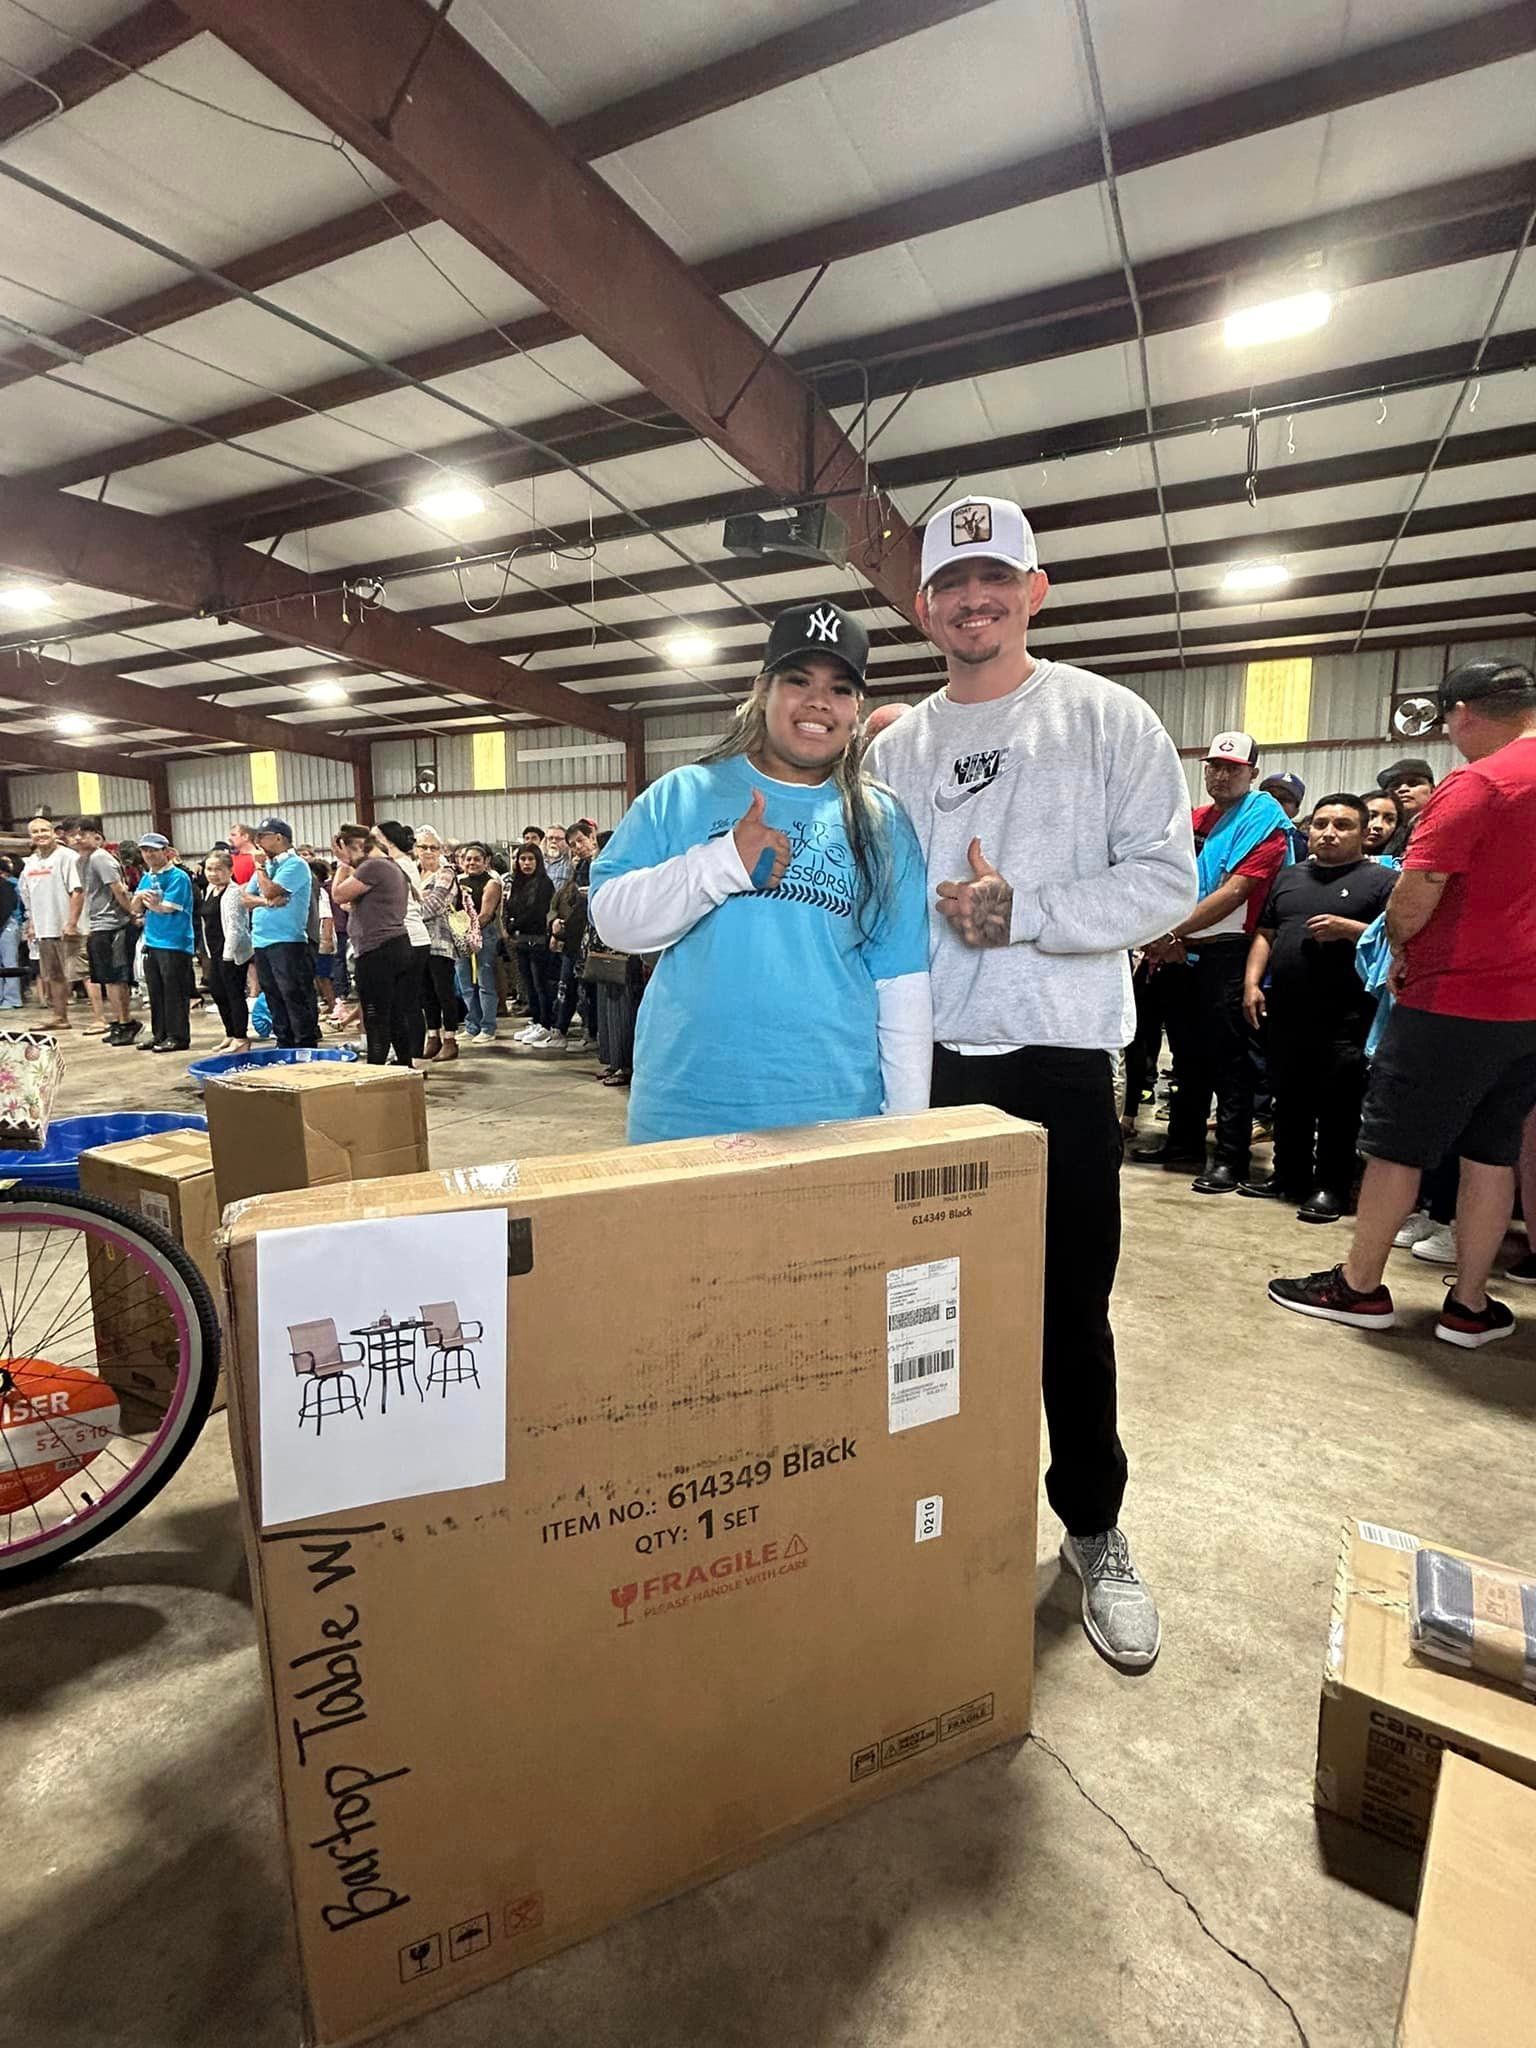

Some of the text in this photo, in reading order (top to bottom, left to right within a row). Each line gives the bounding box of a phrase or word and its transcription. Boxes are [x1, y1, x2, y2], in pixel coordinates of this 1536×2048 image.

[806, 608, 841, 642] NY
[911, 1206, 973, 1226] 614349 Black
[542, 1437, 857, 1544] ITEM NO.: 614349 Black
[635, 1505, 760, 1554] QTY: 1 SET
[923, 1502, 935, 1534] 0210
[643, 1541, 778, 1601] FRAGILE
[644, 1558, 809, 1618] PLEASE HANDLE WITH CARE
[289, 1604, 369, 1767] Table
